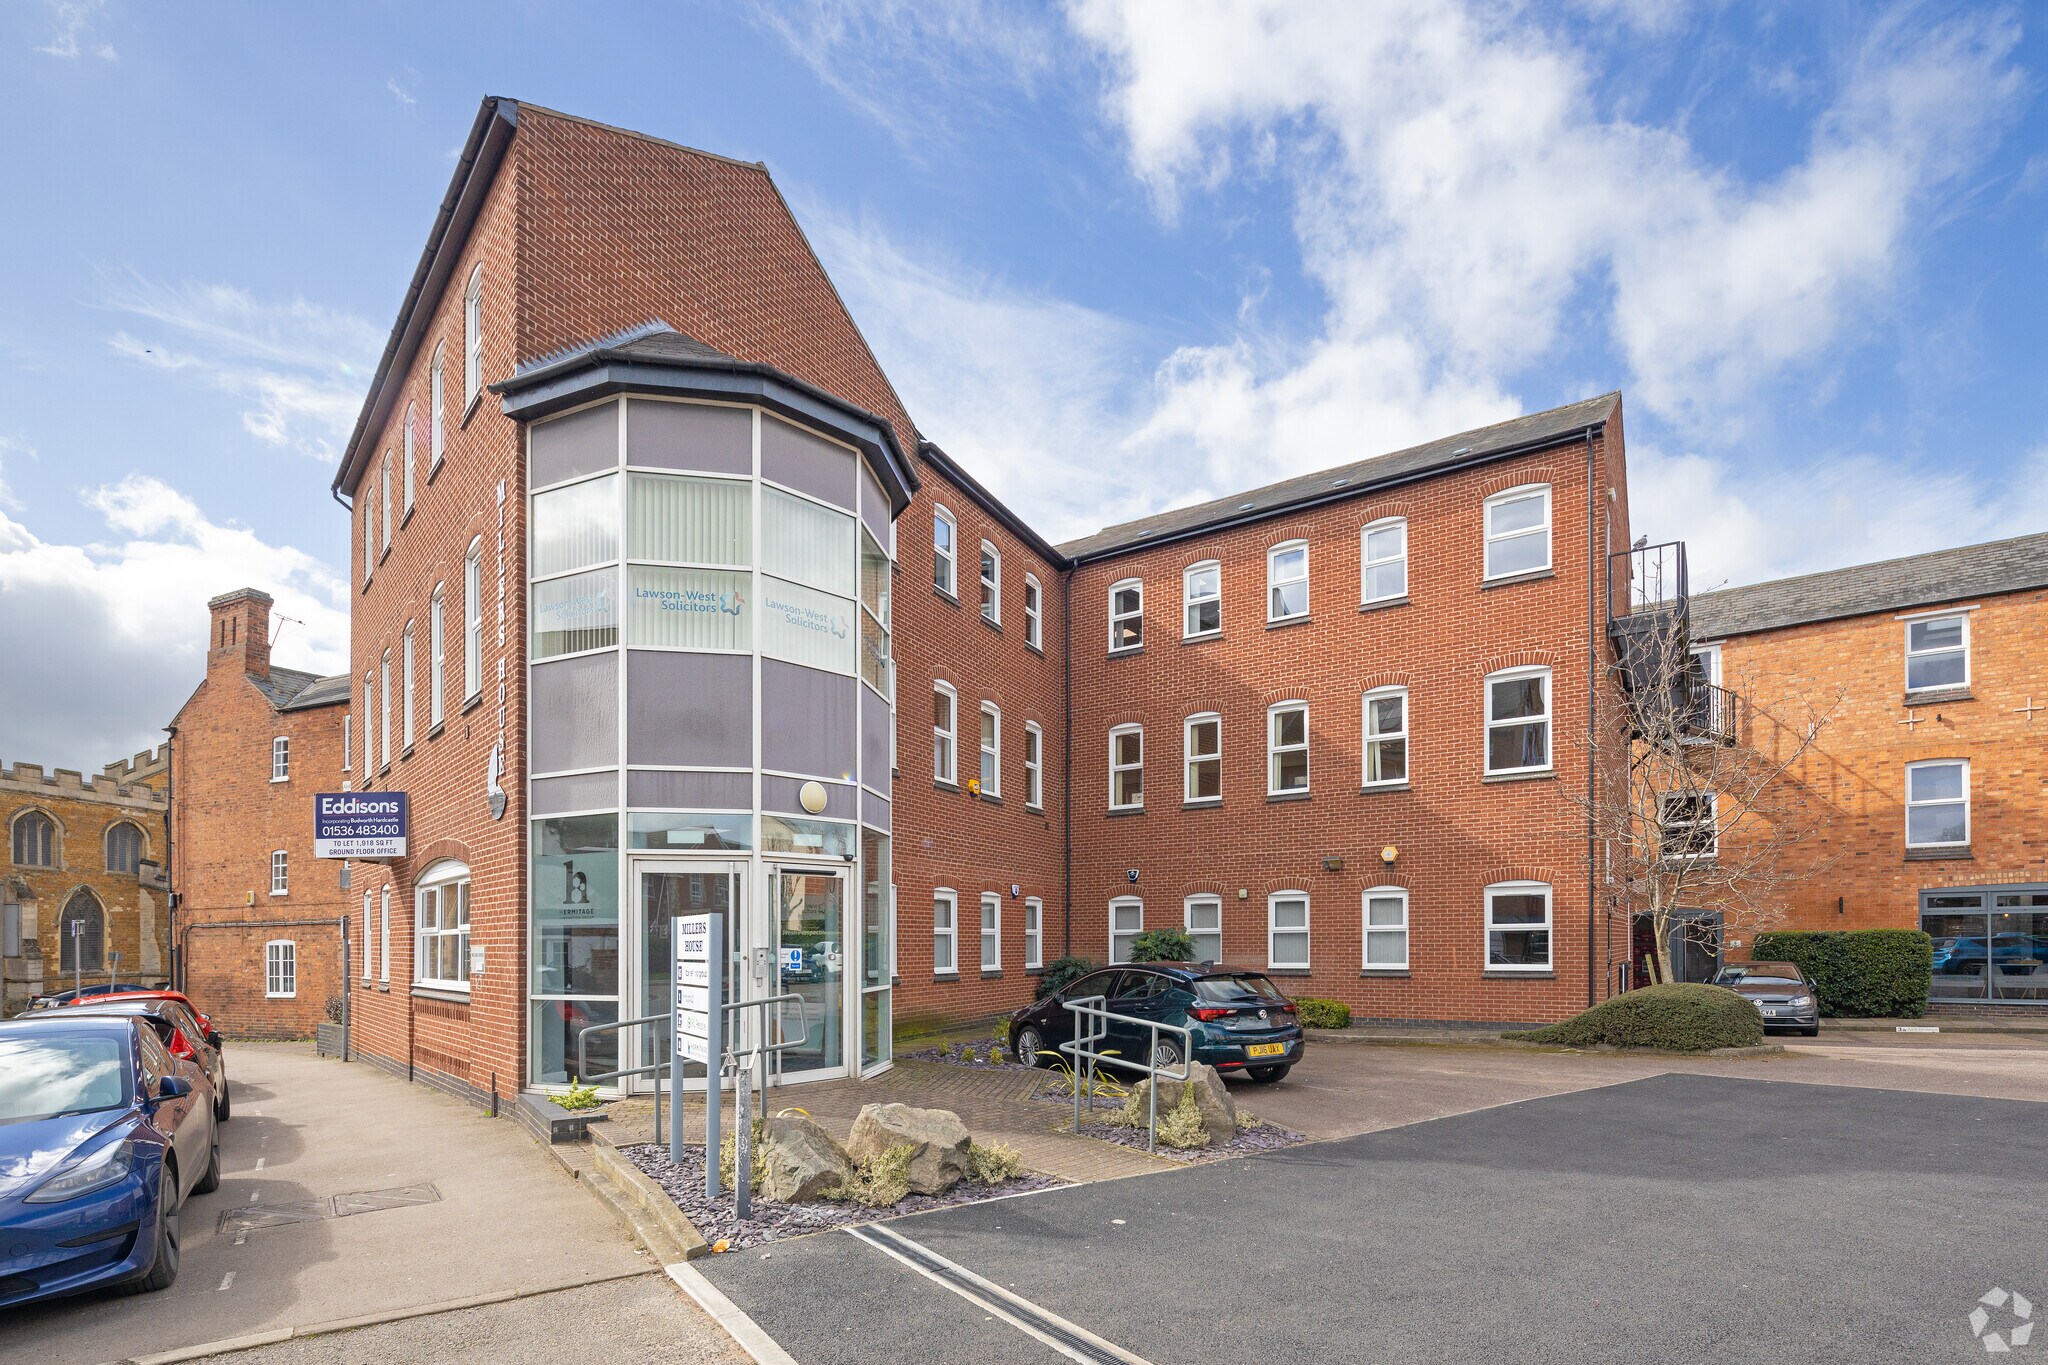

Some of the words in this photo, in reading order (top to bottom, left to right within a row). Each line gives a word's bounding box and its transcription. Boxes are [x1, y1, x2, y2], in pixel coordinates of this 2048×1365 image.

[496, 479, 506, 648] MILLERS
[636, 587, 716, 602] Lawson-West
[539, 593, 594, 614] Lawson-West
[661, 600, 716, 613] Solicitors
[765, 597, 828, 622] Lawson-West
[556, 606, 594, 621] Solicitors
[785, 614, 829, 633] Solicitors
[497, 657, 506, 776] HOUSE
[322, 797, 399, 815] Eddisons
[322, 826, 354, 836] 01536
[356, 825, 399, 836] 483400
[681, 922, 707, 935] MILLERS
[684, 940, 703, 952] HOUSE
